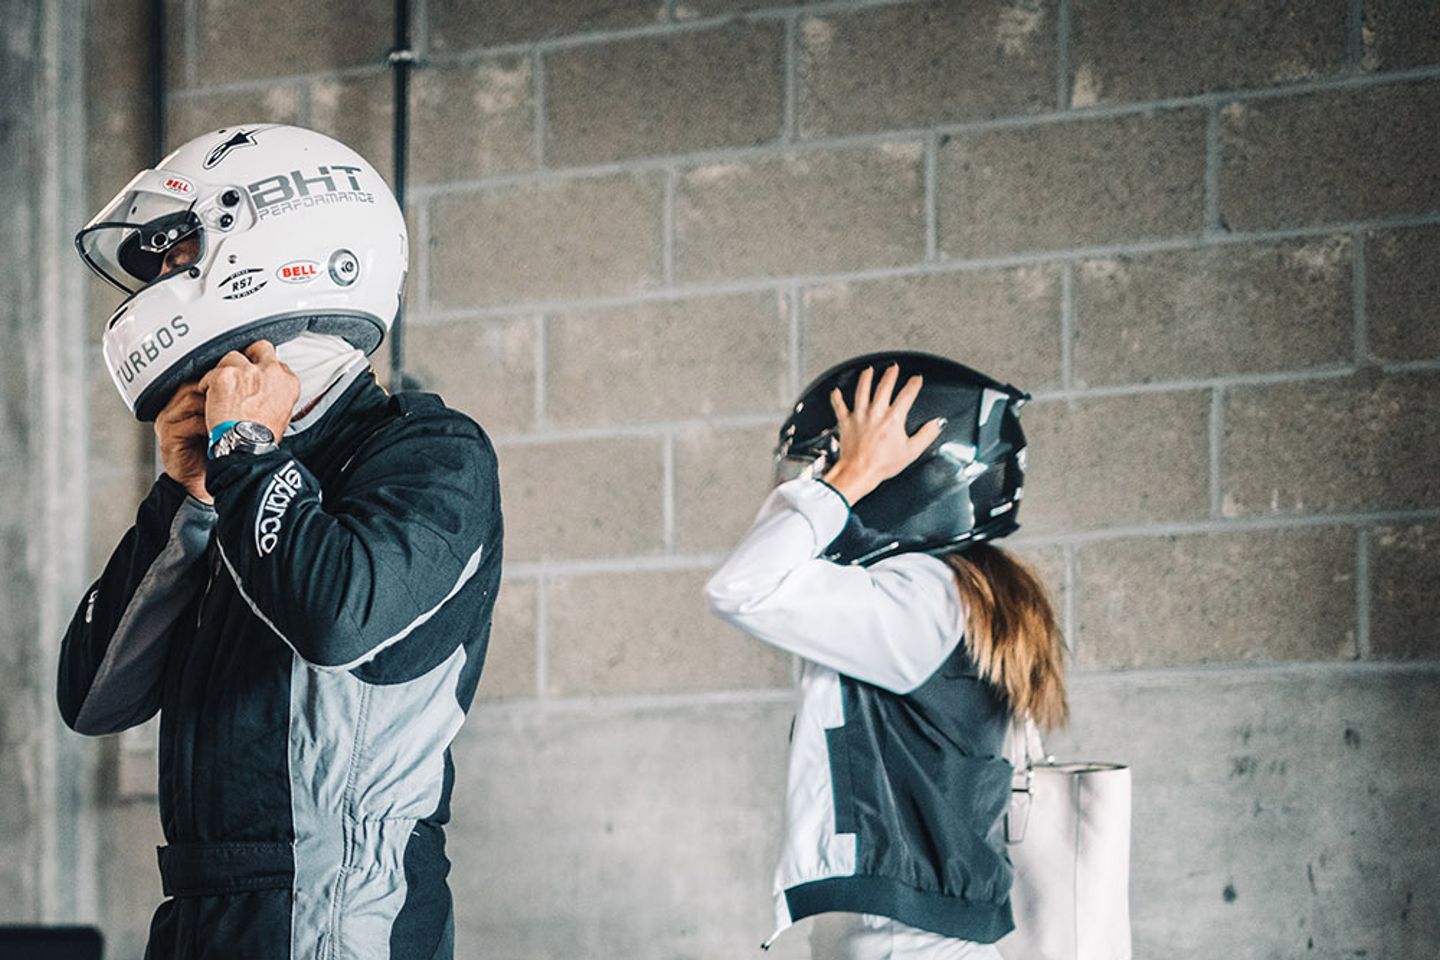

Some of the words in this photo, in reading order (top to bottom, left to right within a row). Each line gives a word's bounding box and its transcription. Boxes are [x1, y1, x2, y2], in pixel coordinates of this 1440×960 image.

[166, 179, 189, 192] BELL
[247, 165, 362, 210] BHT
[258, 191, 375, 220] PERFORMANCE
[282, 264, 318, 278] BELL
[232, 276, 253, 292] RS7
[257, 464, 303, 555] sparco
